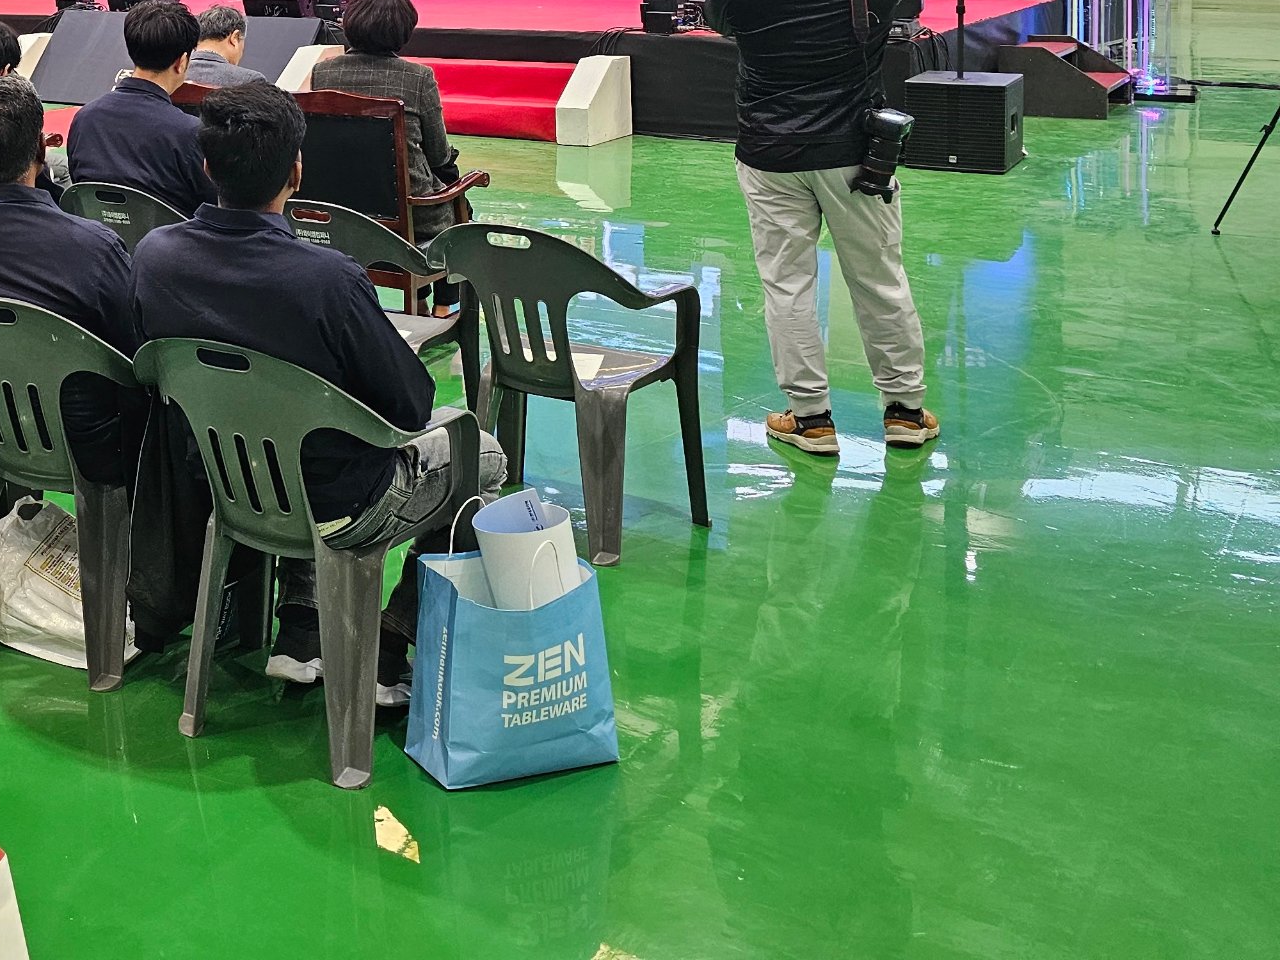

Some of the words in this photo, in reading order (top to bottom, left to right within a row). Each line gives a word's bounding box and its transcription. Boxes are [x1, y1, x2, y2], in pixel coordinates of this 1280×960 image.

[503, 632, 586, 687] ZEN
[502, 671, 587, 709] PREMIUM
[501, 693, 587, 728] TABLEWARE
